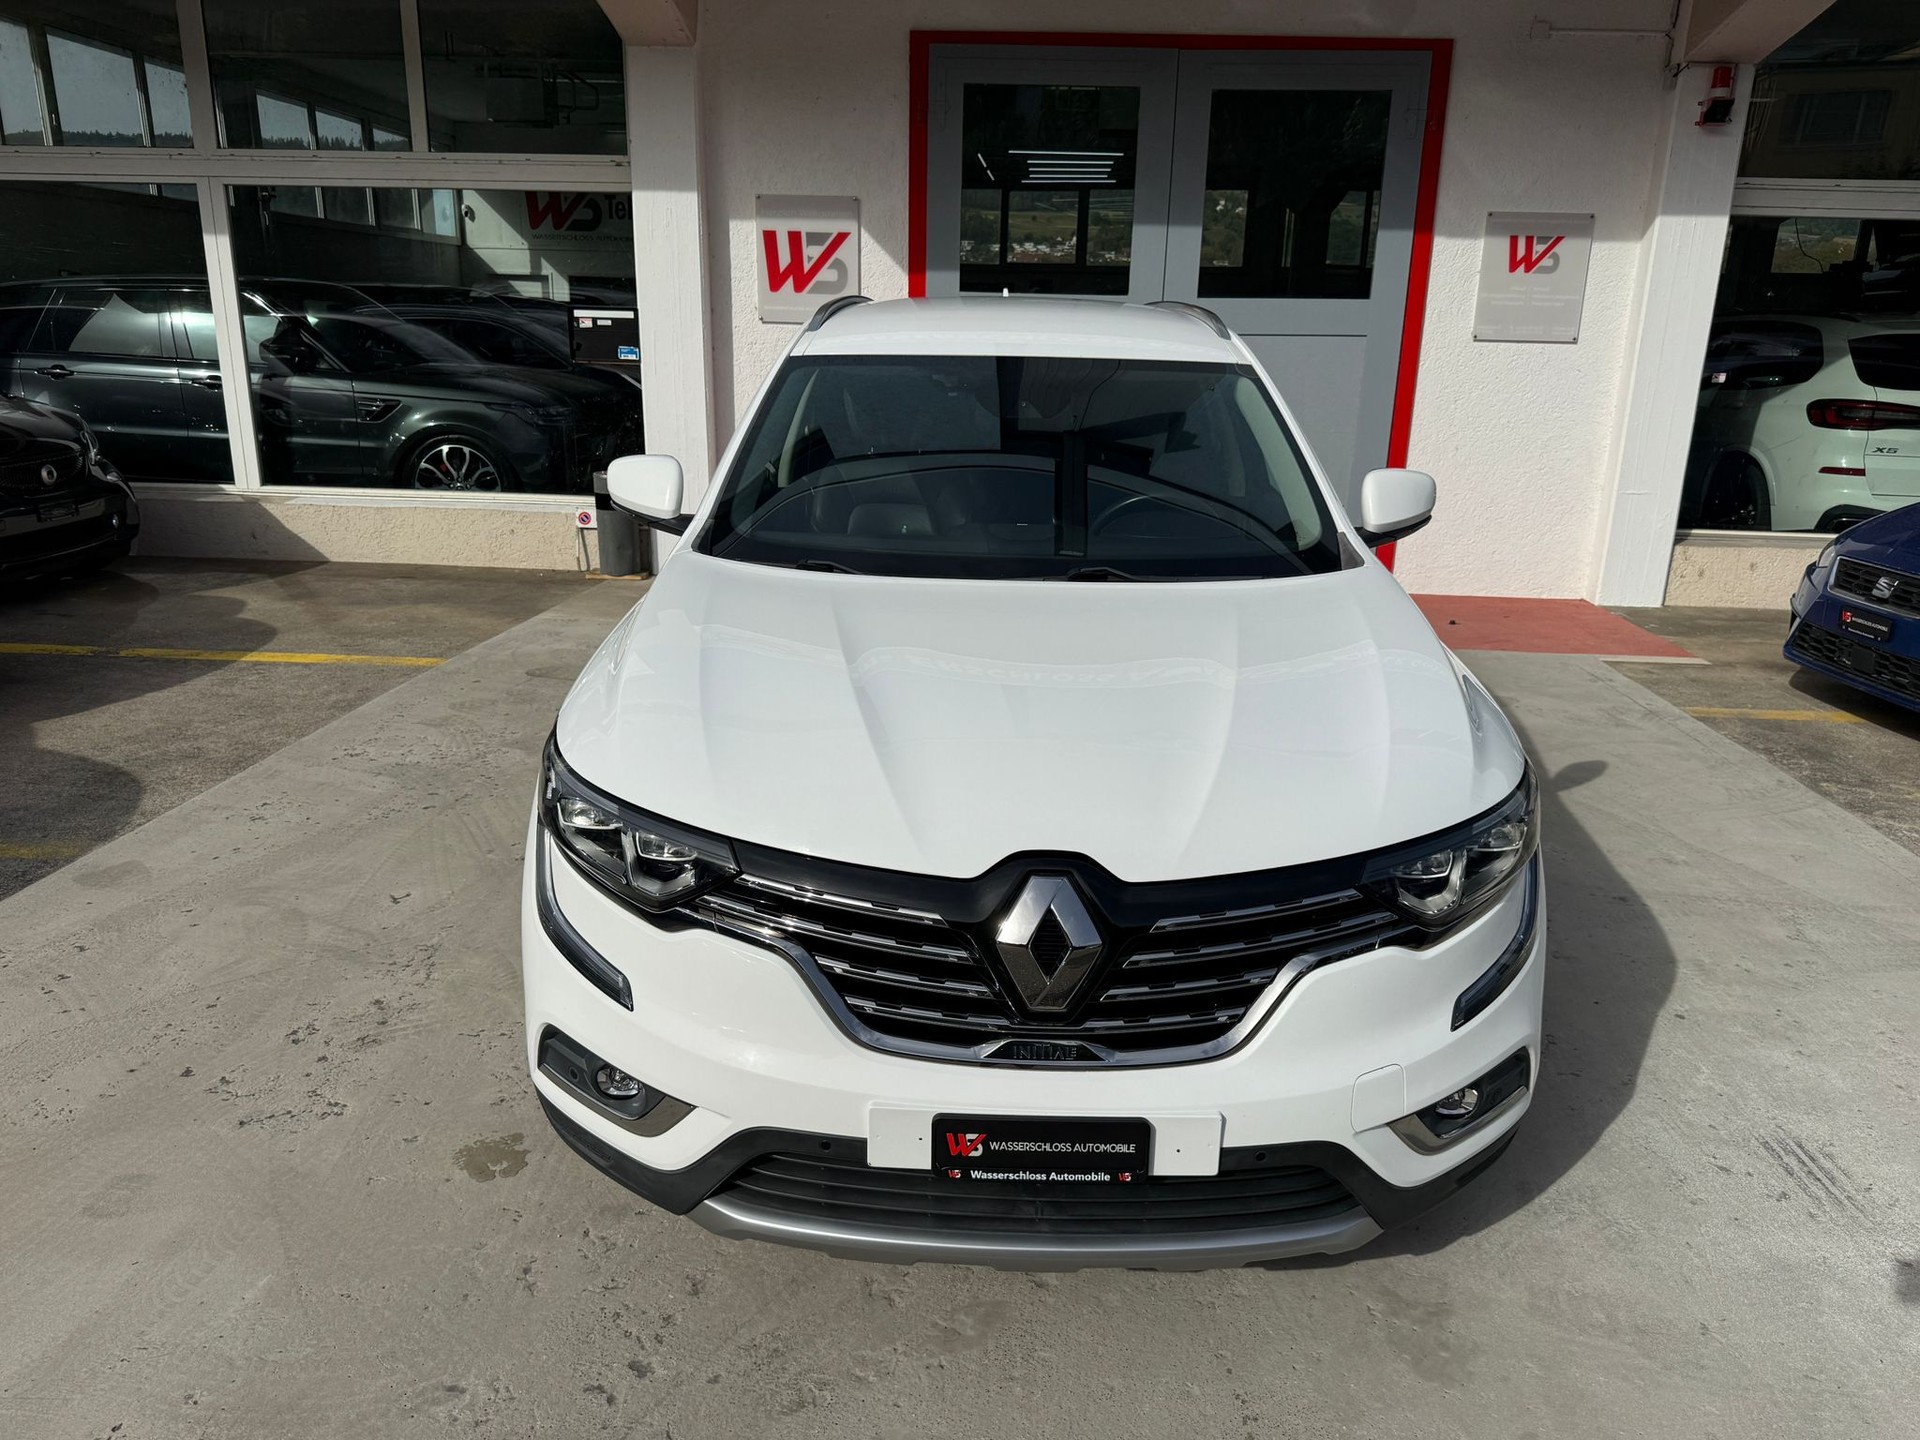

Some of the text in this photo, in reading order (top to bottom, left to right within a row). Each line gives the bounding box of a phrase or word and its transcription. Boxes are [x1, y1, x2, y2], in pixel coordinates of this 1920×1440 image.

[989, 1141, 1072, 1152] WASSERSCHLOSS
[1073, 1143, 1136, 1154] AUTOMOBILE
[970, 1169, 1047, 1181] Wasserschloss
[1049, 1171, 1111, 1182] Automobile
